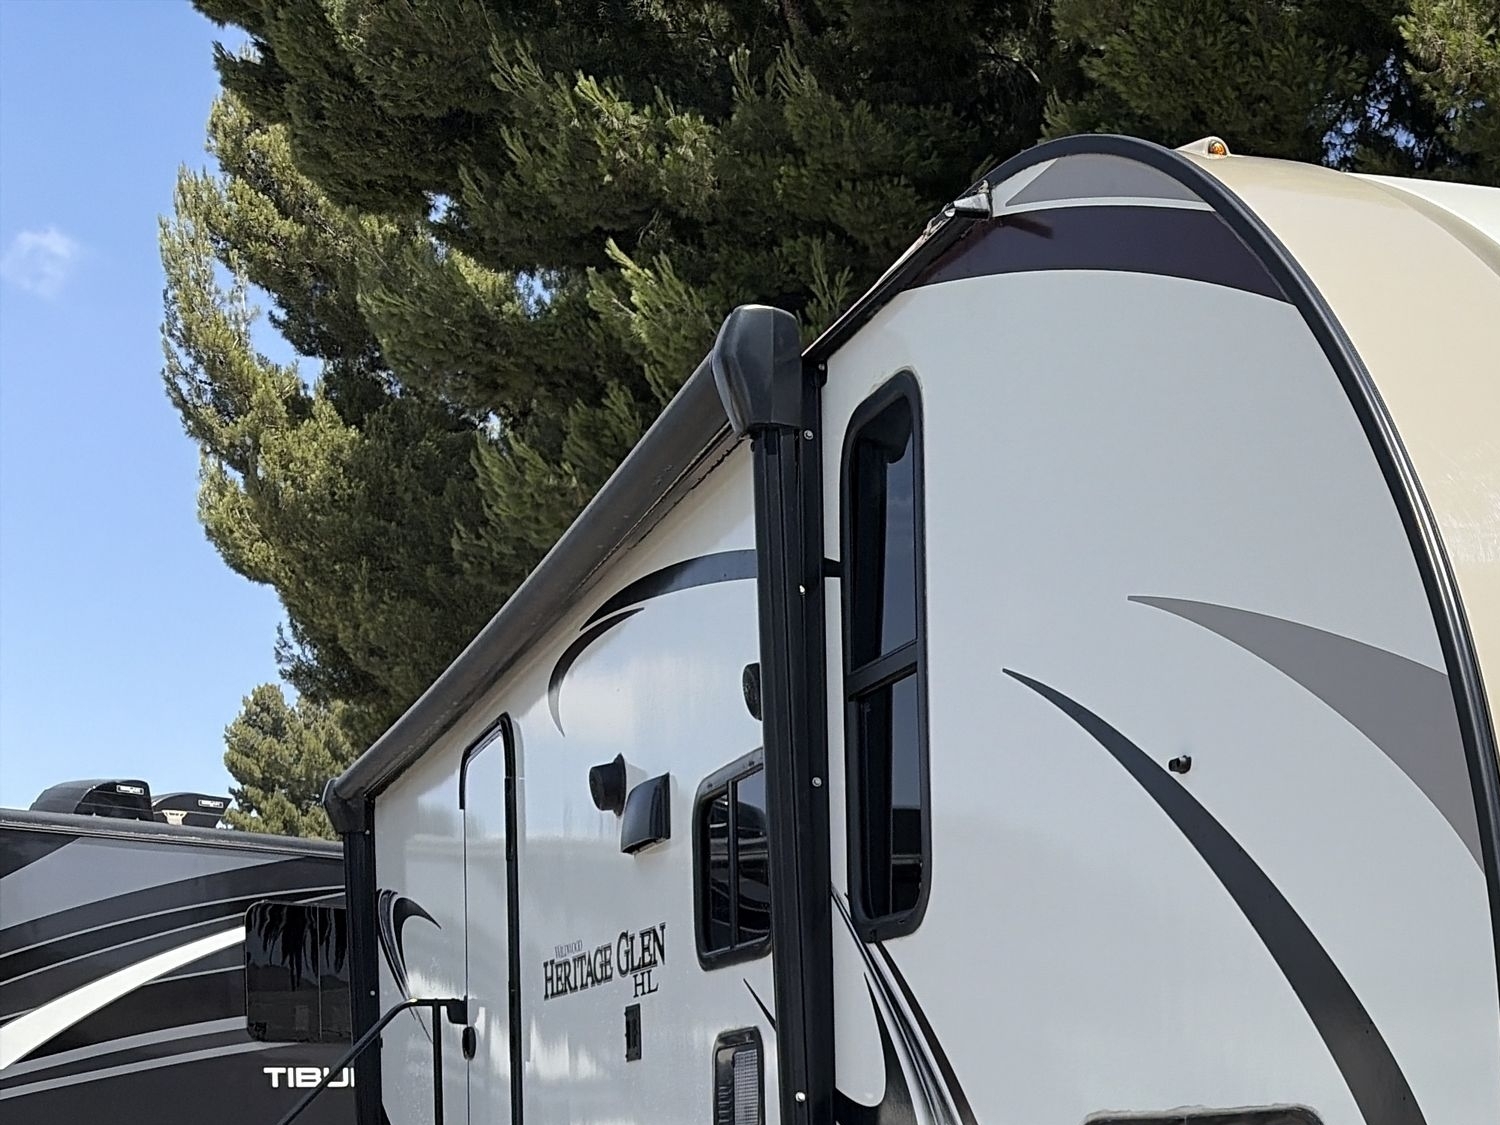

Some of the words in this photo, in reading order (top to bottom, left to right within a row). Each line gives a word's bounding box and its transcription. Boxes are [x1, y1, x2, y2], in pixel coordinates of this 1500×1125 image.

[543, 942, 614, 1001] HERITAGE
[616, 921, 667, 978] GLEN
[632, 968, 660, 999] HL
